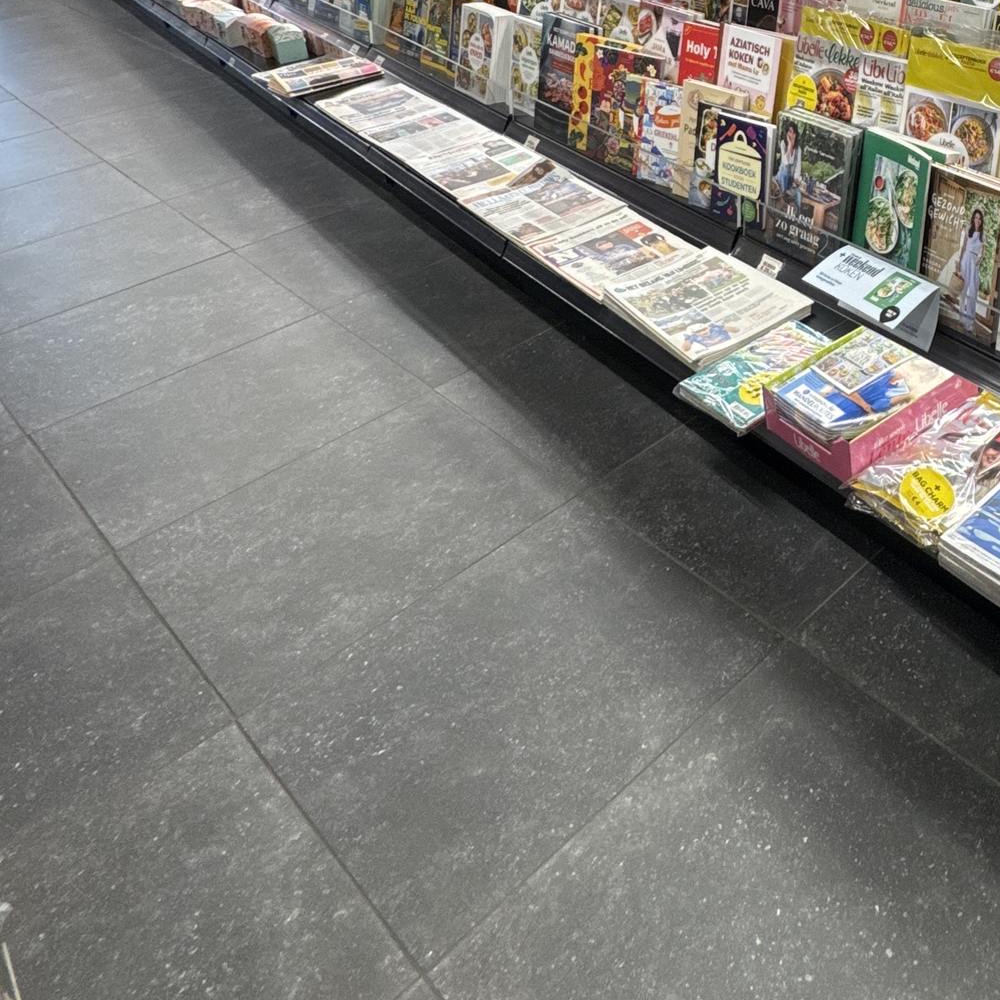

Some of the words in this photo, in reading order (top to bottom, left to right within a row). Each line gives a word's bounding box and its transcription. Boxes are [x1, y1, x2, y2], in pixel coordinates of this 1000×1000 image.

[686, 40, 710, 59] Holy
[730, 37, 770, 55] AZIATISCH
[728, 50, 753, 64] KOKEN
[723, 162, 756, 178] KOOKBOEK
[721, 177, 757, 194] STUDENTEN
[931, 193, 966, 216] GEZOND
[912, 471, 926, 489] BAG
[924, 485, 949, 512] CHARM
